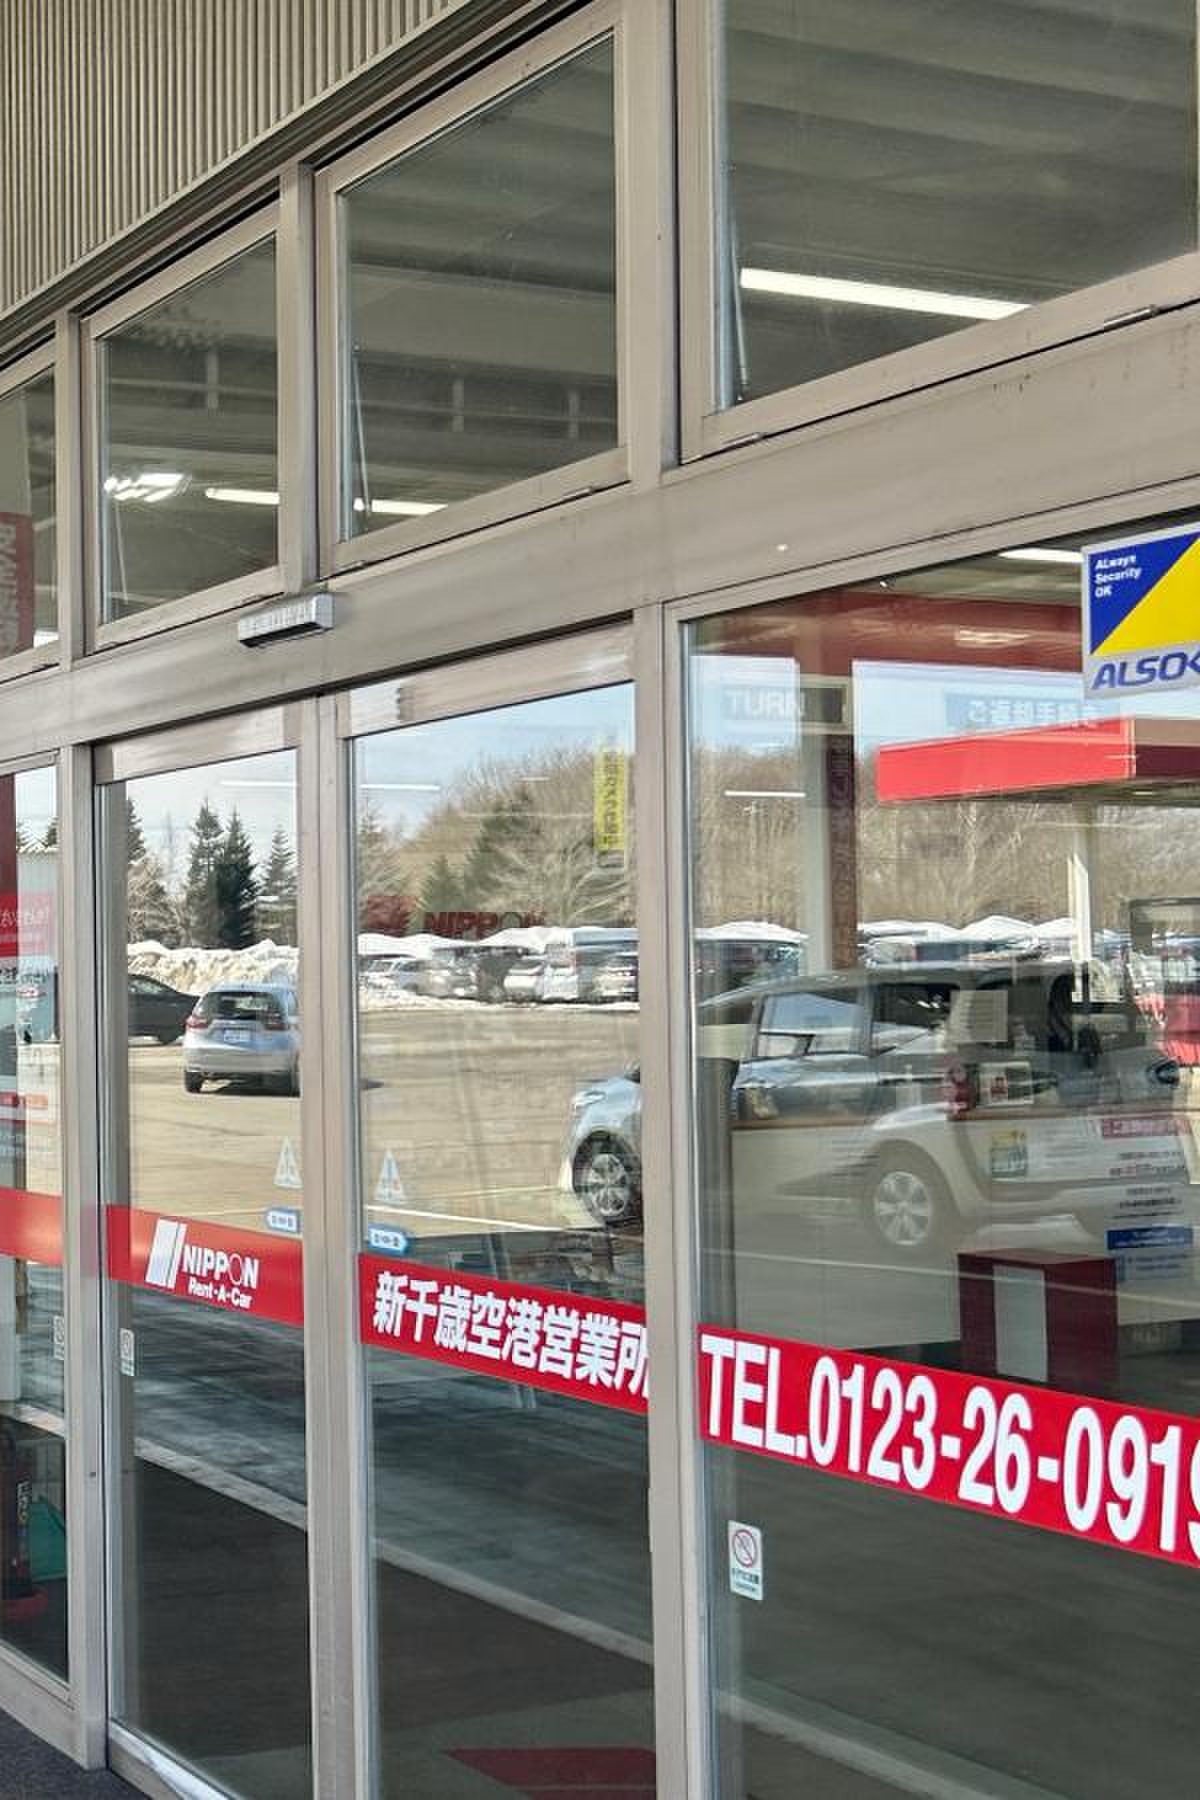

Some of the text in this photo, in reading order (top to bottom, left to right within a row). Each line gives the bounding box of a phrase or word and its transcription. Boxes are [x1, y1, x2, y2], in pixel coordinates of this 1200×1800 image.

[1094, 567, 1142, 585] Security
[1094, 585, 1113, 599] OK
[182, 1244, 259, 1289] NIPPON
[373, 1271, 648, 1398] 新千歳空港営業所
